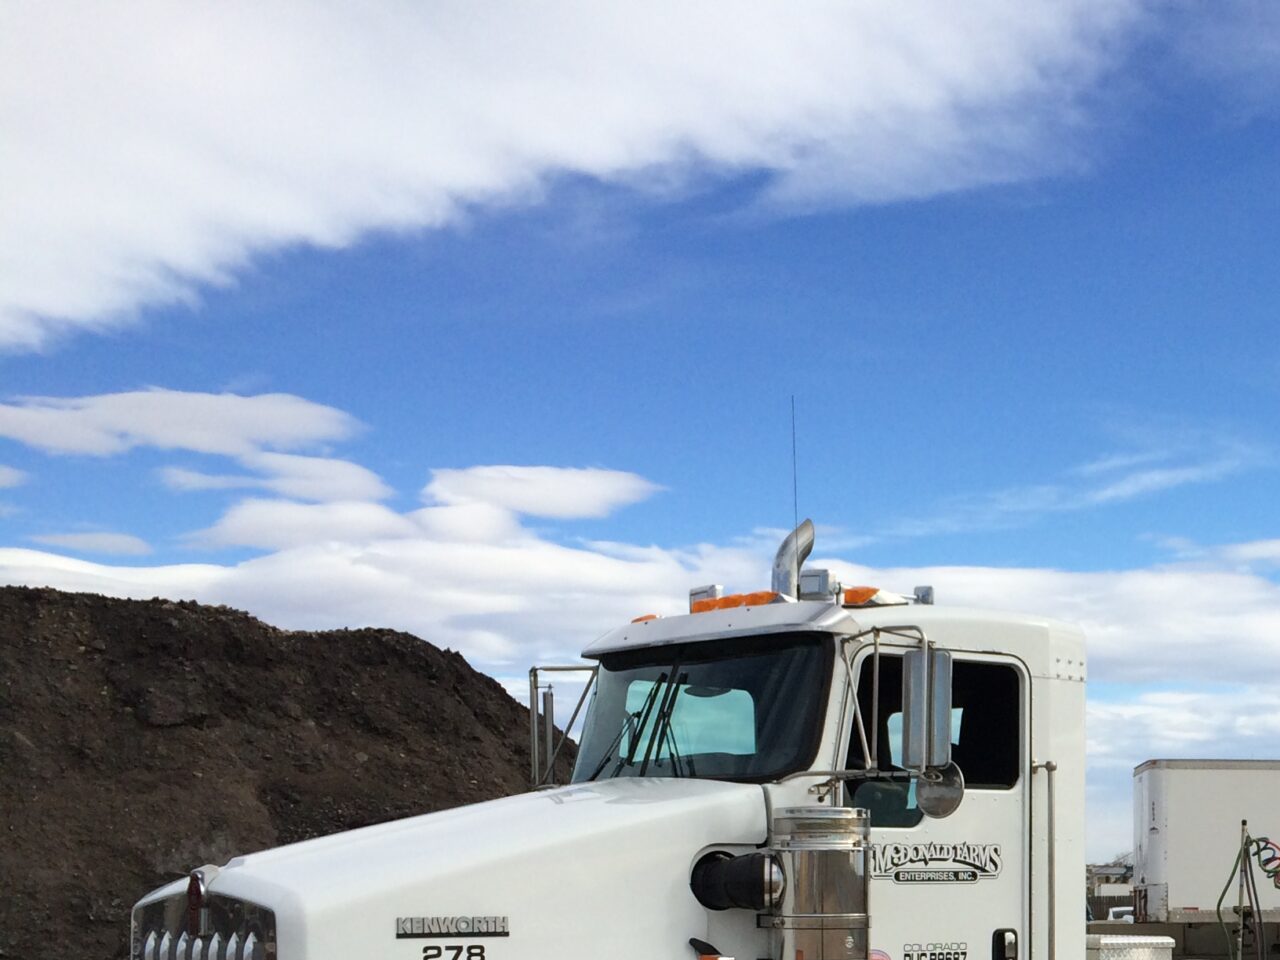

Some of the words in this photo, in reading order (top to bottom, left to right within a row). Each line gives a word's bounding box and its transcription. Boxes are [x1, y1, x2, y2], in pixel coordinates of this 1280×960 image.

[954, 841, 1002, 873] FARMS
[899, 871, 957, 881] ENTERPRISES,
[958, 871, 975, 880] INC.
[396, 916, 509, 935] KENWORTH
[903, 942, 968, 952] COLORADO
